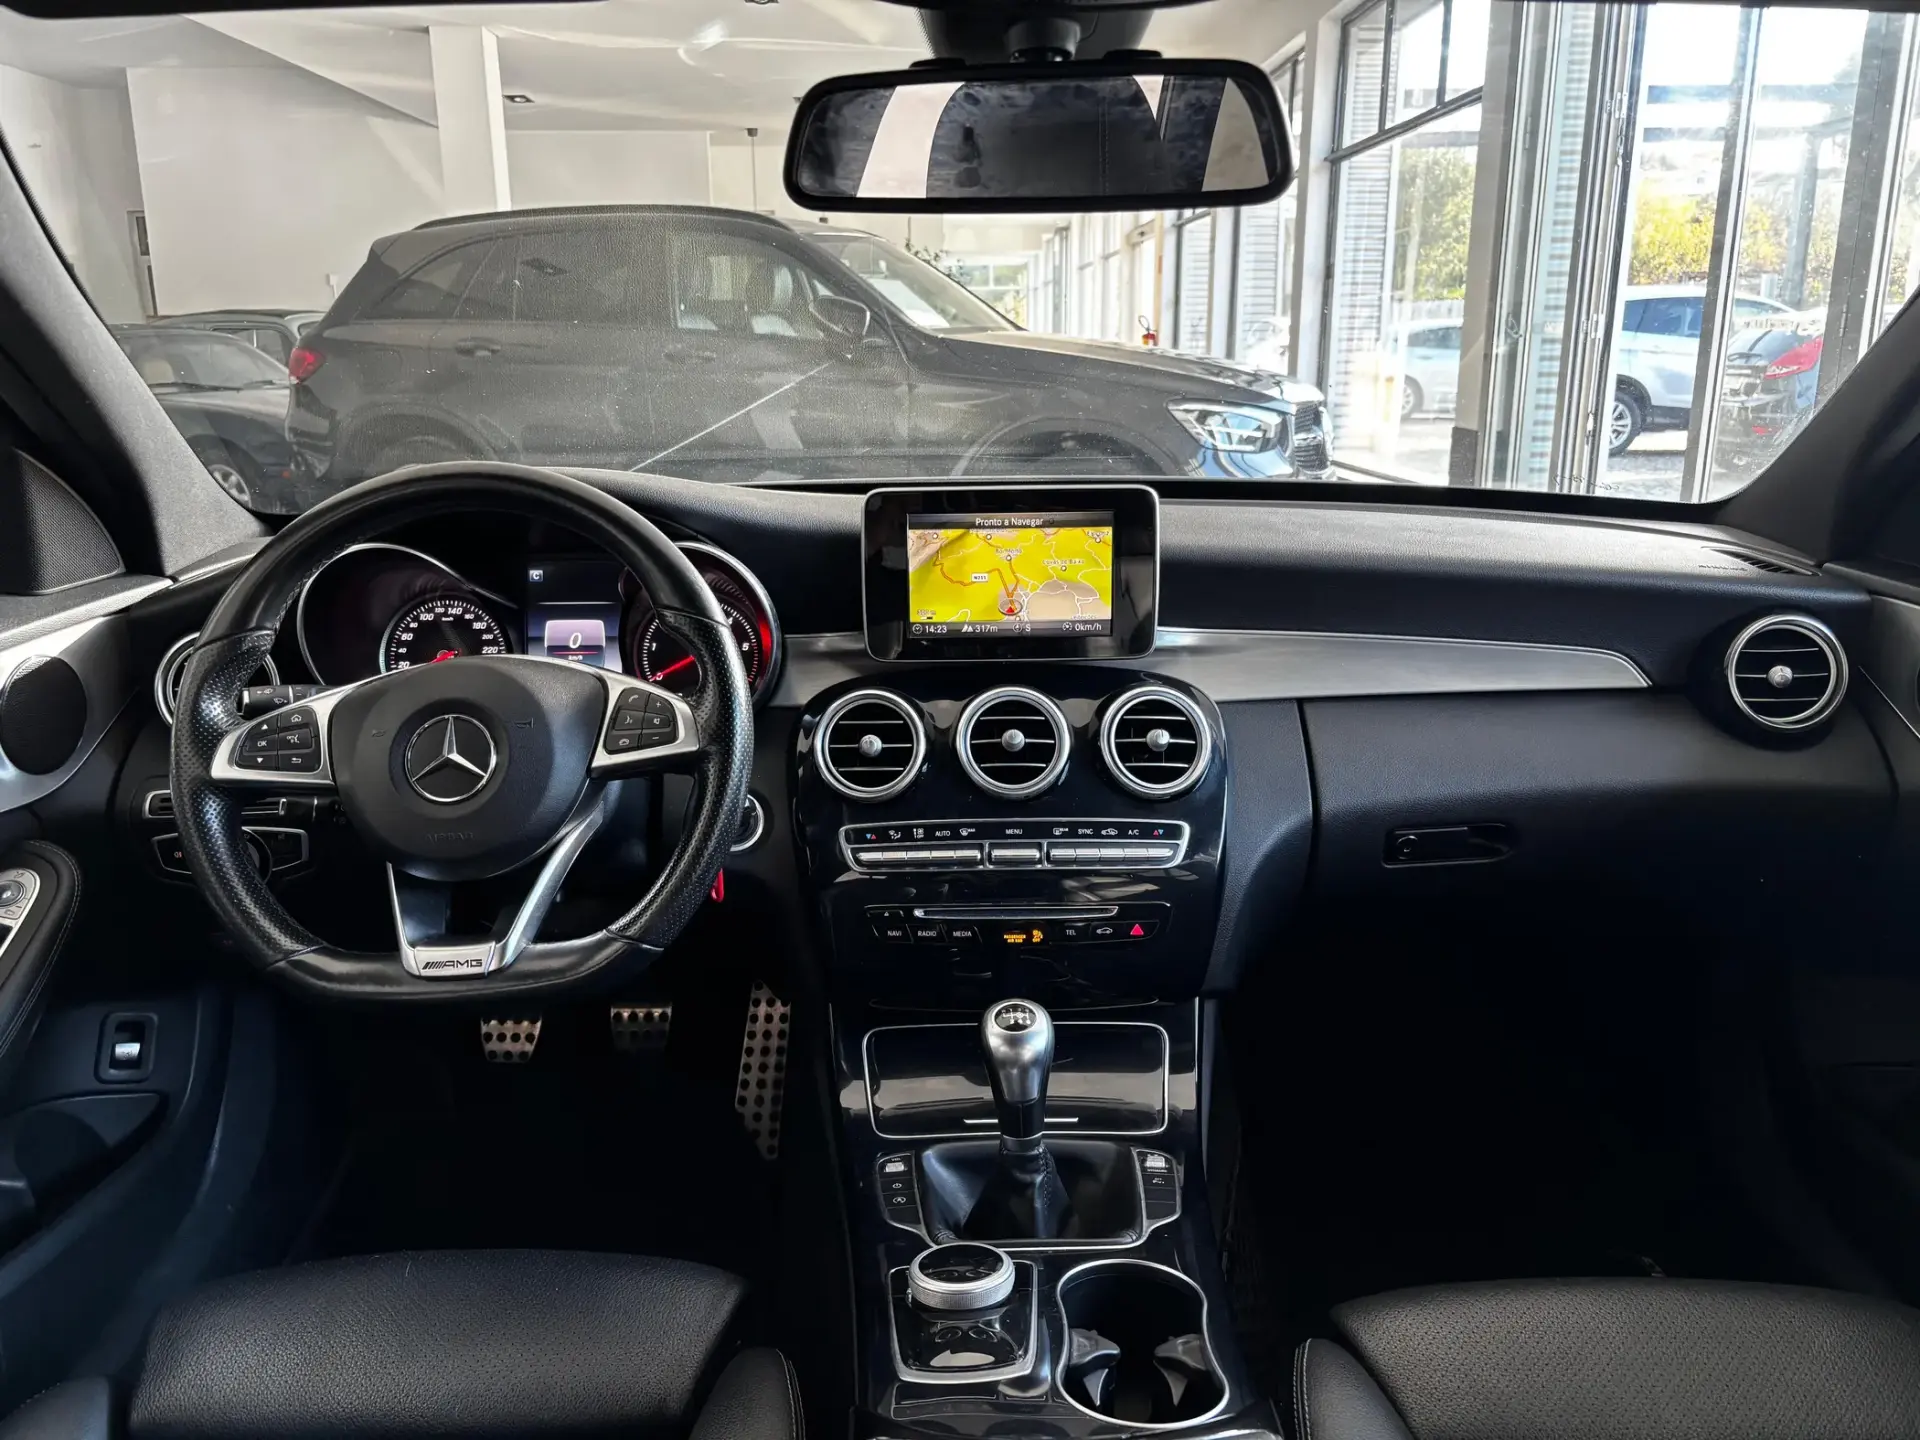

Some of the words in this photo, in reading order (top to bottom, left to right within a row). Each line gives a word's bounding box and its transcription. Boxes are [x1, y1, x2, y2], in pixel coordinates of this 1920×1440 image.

[975, 518, 1002, 526] Pronto
[1011, 518, 1044, 528] Navegar
[447, 607, 462, 615] 140
[419, 613, 434, 621] 100
[472, 621, 487, 630] 180
[925, 625, 948, 634] 14:23
[975, 624, 998, 633] 317m
[1025, 624, 1031, 632] S
[1074, 623, 1102, 631] 0km/h
[401, 633, 413, 641] 60
[569, 632, 582, 649] 0
[482, 646, 498, 654] 220
[742, 642, 750, 651] 5
[398, 661, 410, 669] 20
[442, 958, 483, 970] AMG
